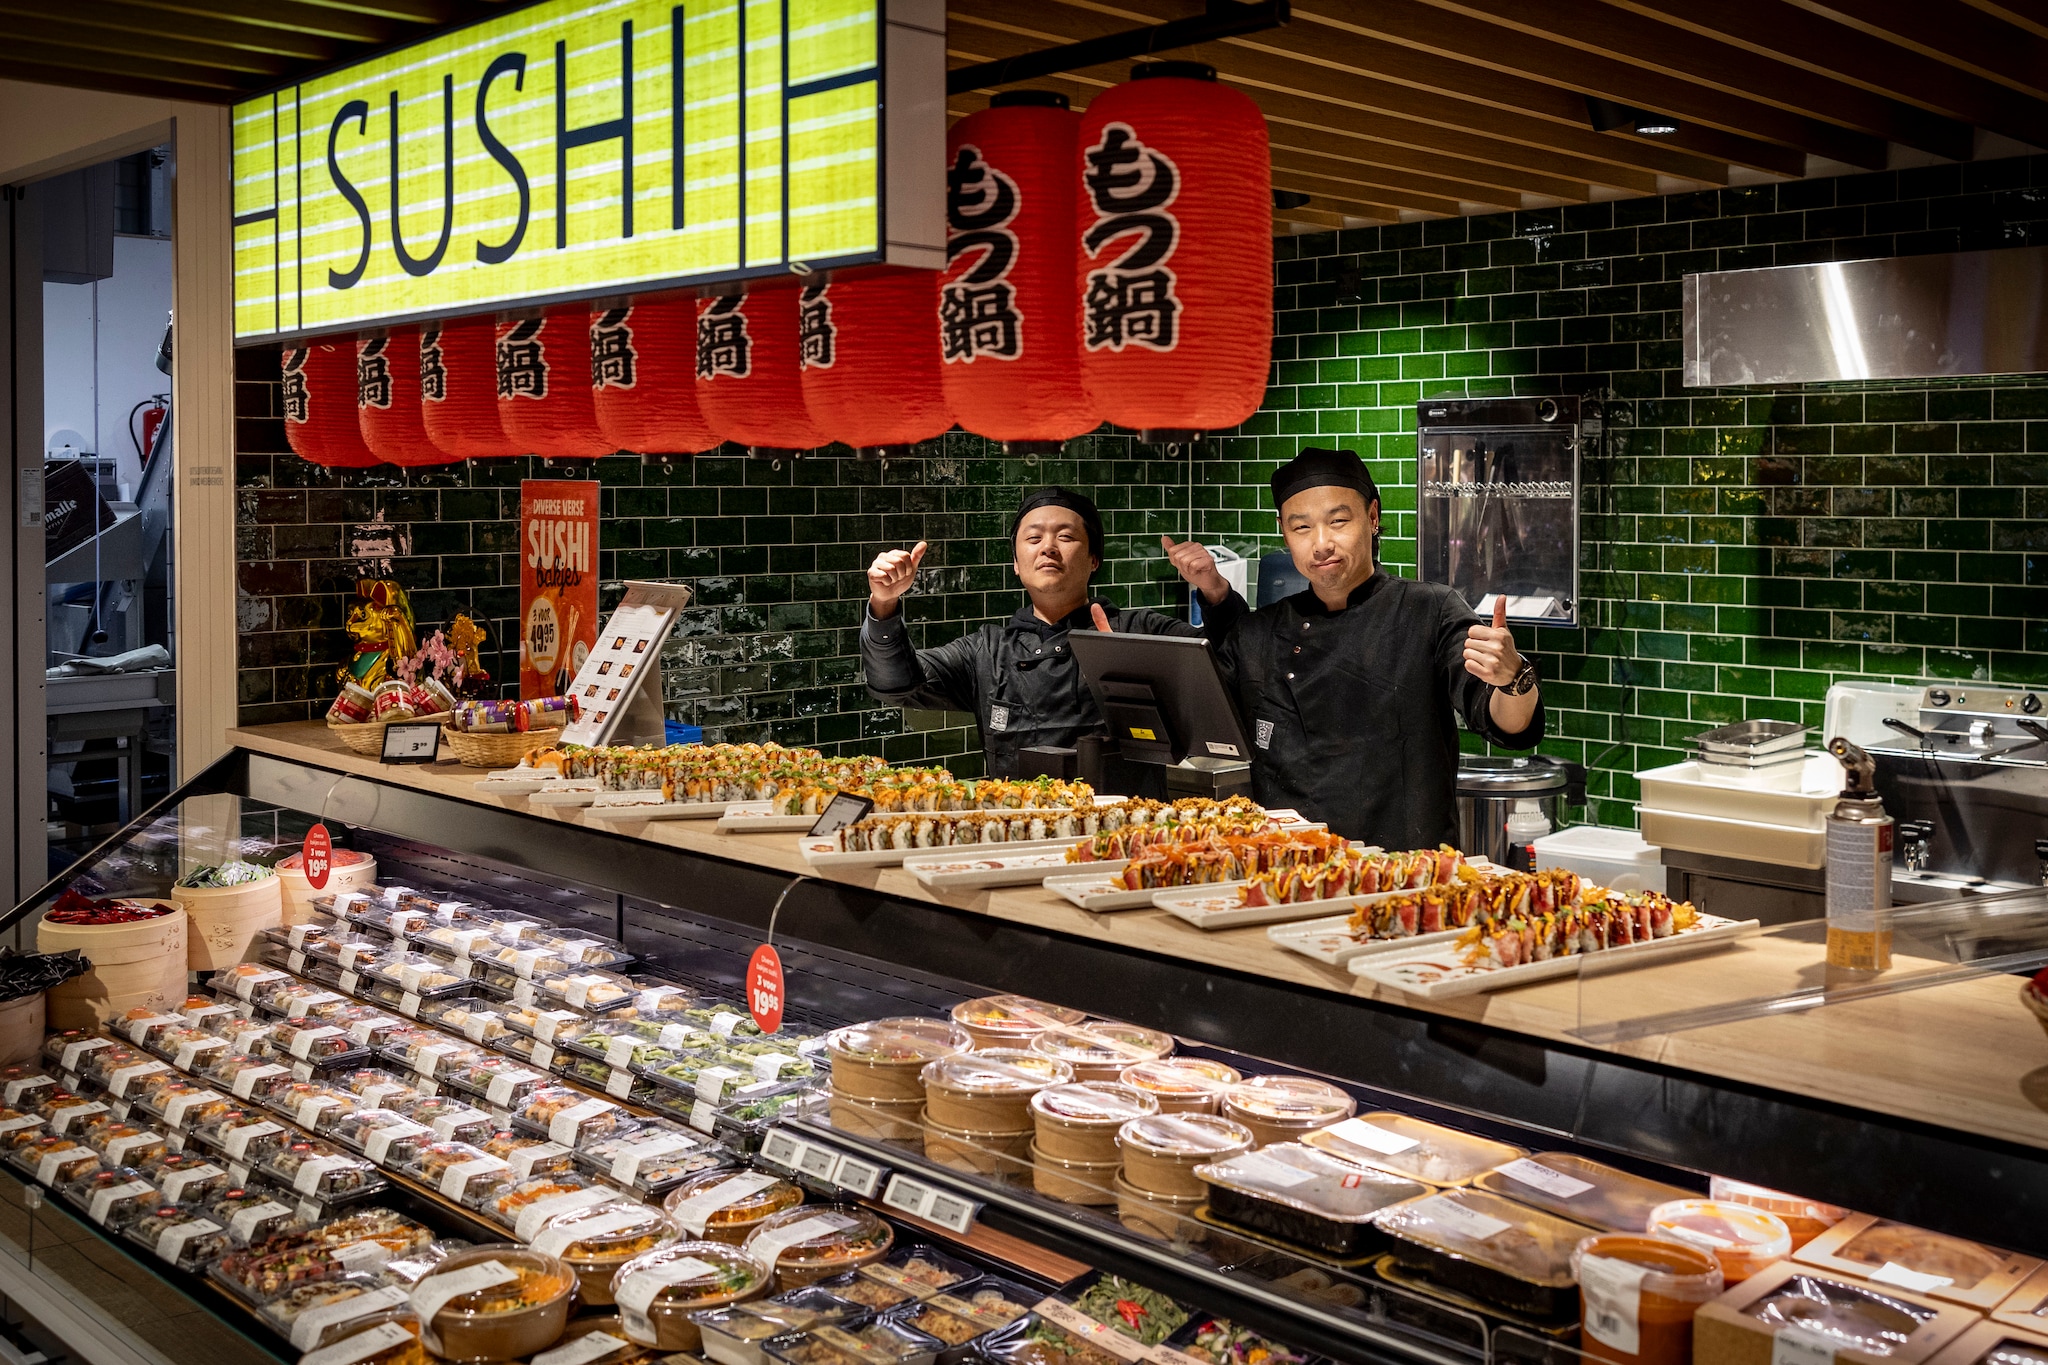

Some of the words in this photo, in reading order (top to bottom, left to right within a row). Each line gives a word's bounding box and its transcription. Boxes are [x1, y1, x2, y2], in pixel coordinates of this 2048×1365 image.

[328, 5, 684, 290] SUSHI
[1084, 124, 1182, 350] もつ鍋
[533, 499, 561, 516] DIVERSE
[562, 499, 585, 517] VERSE
[527, 519, 590, 573] SUSHI
[536, 555, 582, 598] bakjes
[310, 848, 314, 856] 3
[757, 974, 762, 986] 3
[762, 978, 777, 992] voor
